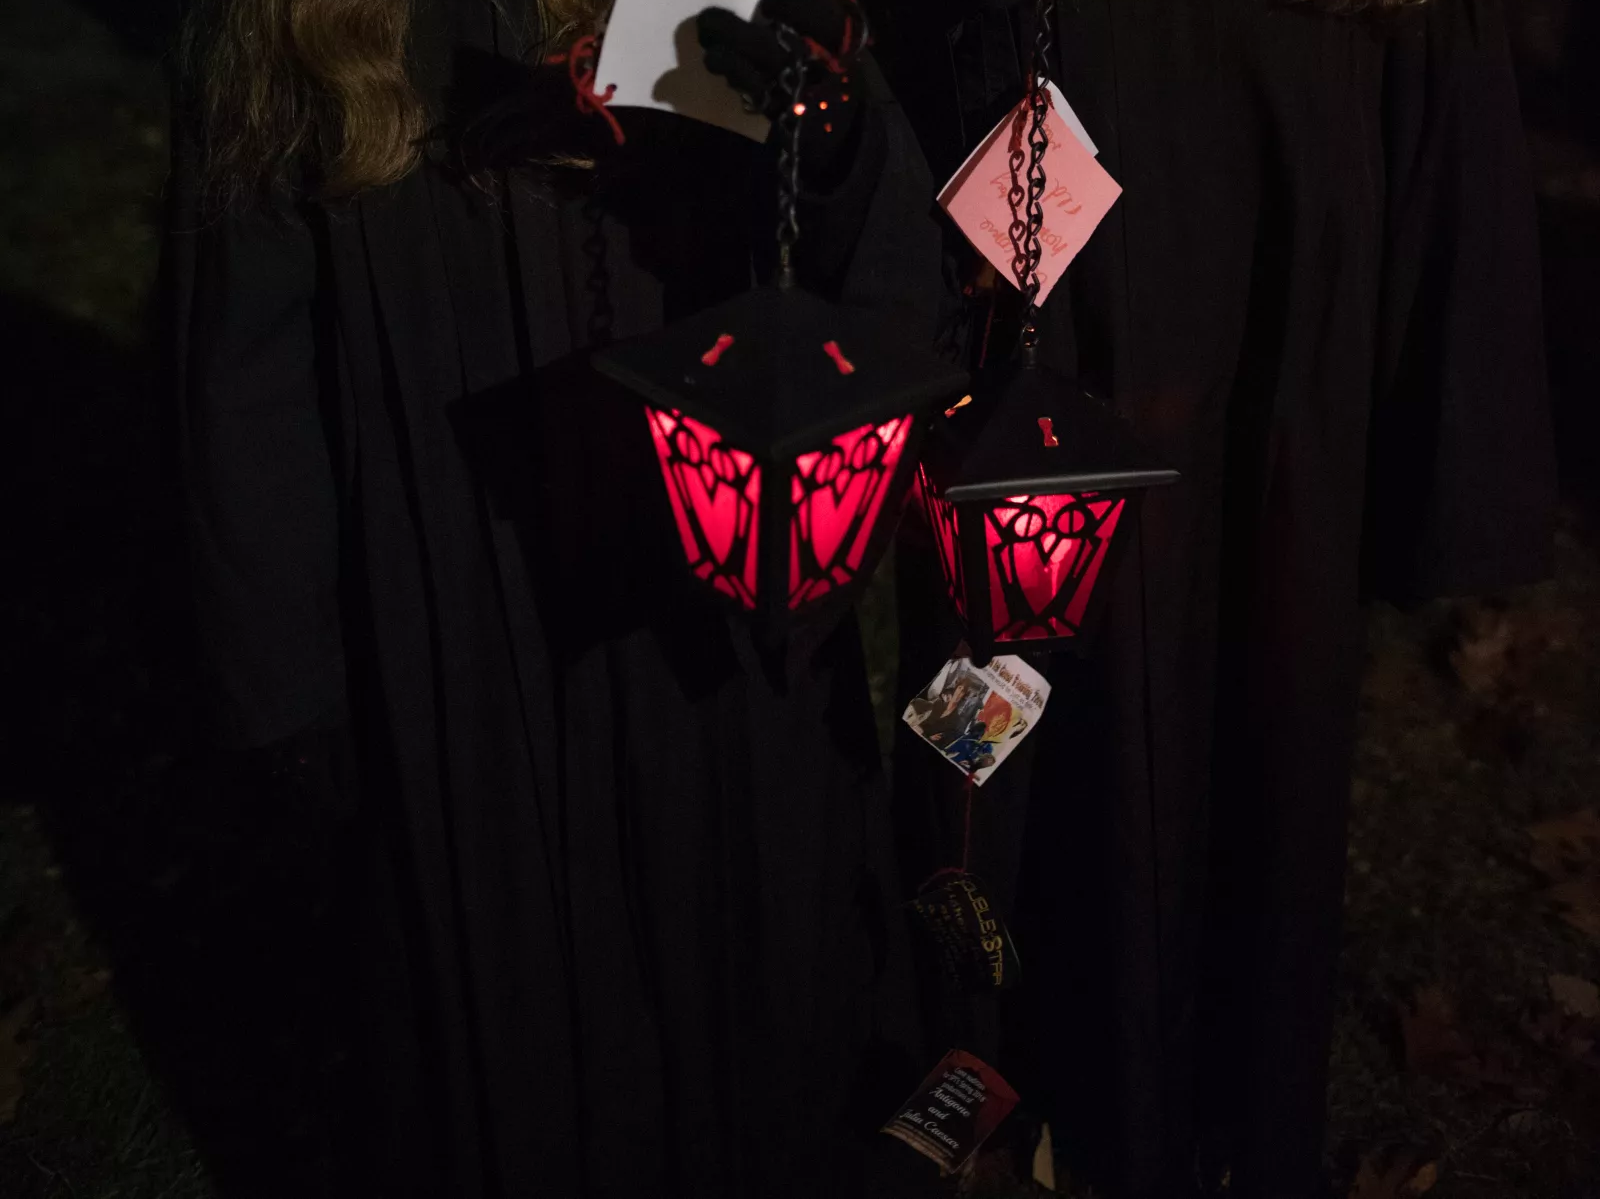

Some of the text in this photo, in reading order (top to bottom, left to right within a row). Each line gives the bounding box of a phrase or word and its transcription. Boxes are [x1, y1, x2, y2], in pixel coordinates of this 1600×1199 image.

[927, 1105, 949, 1121] and
[928, 1086, 970, 1117] Antigone
[923, 1121, 959, 1149] Caesar
